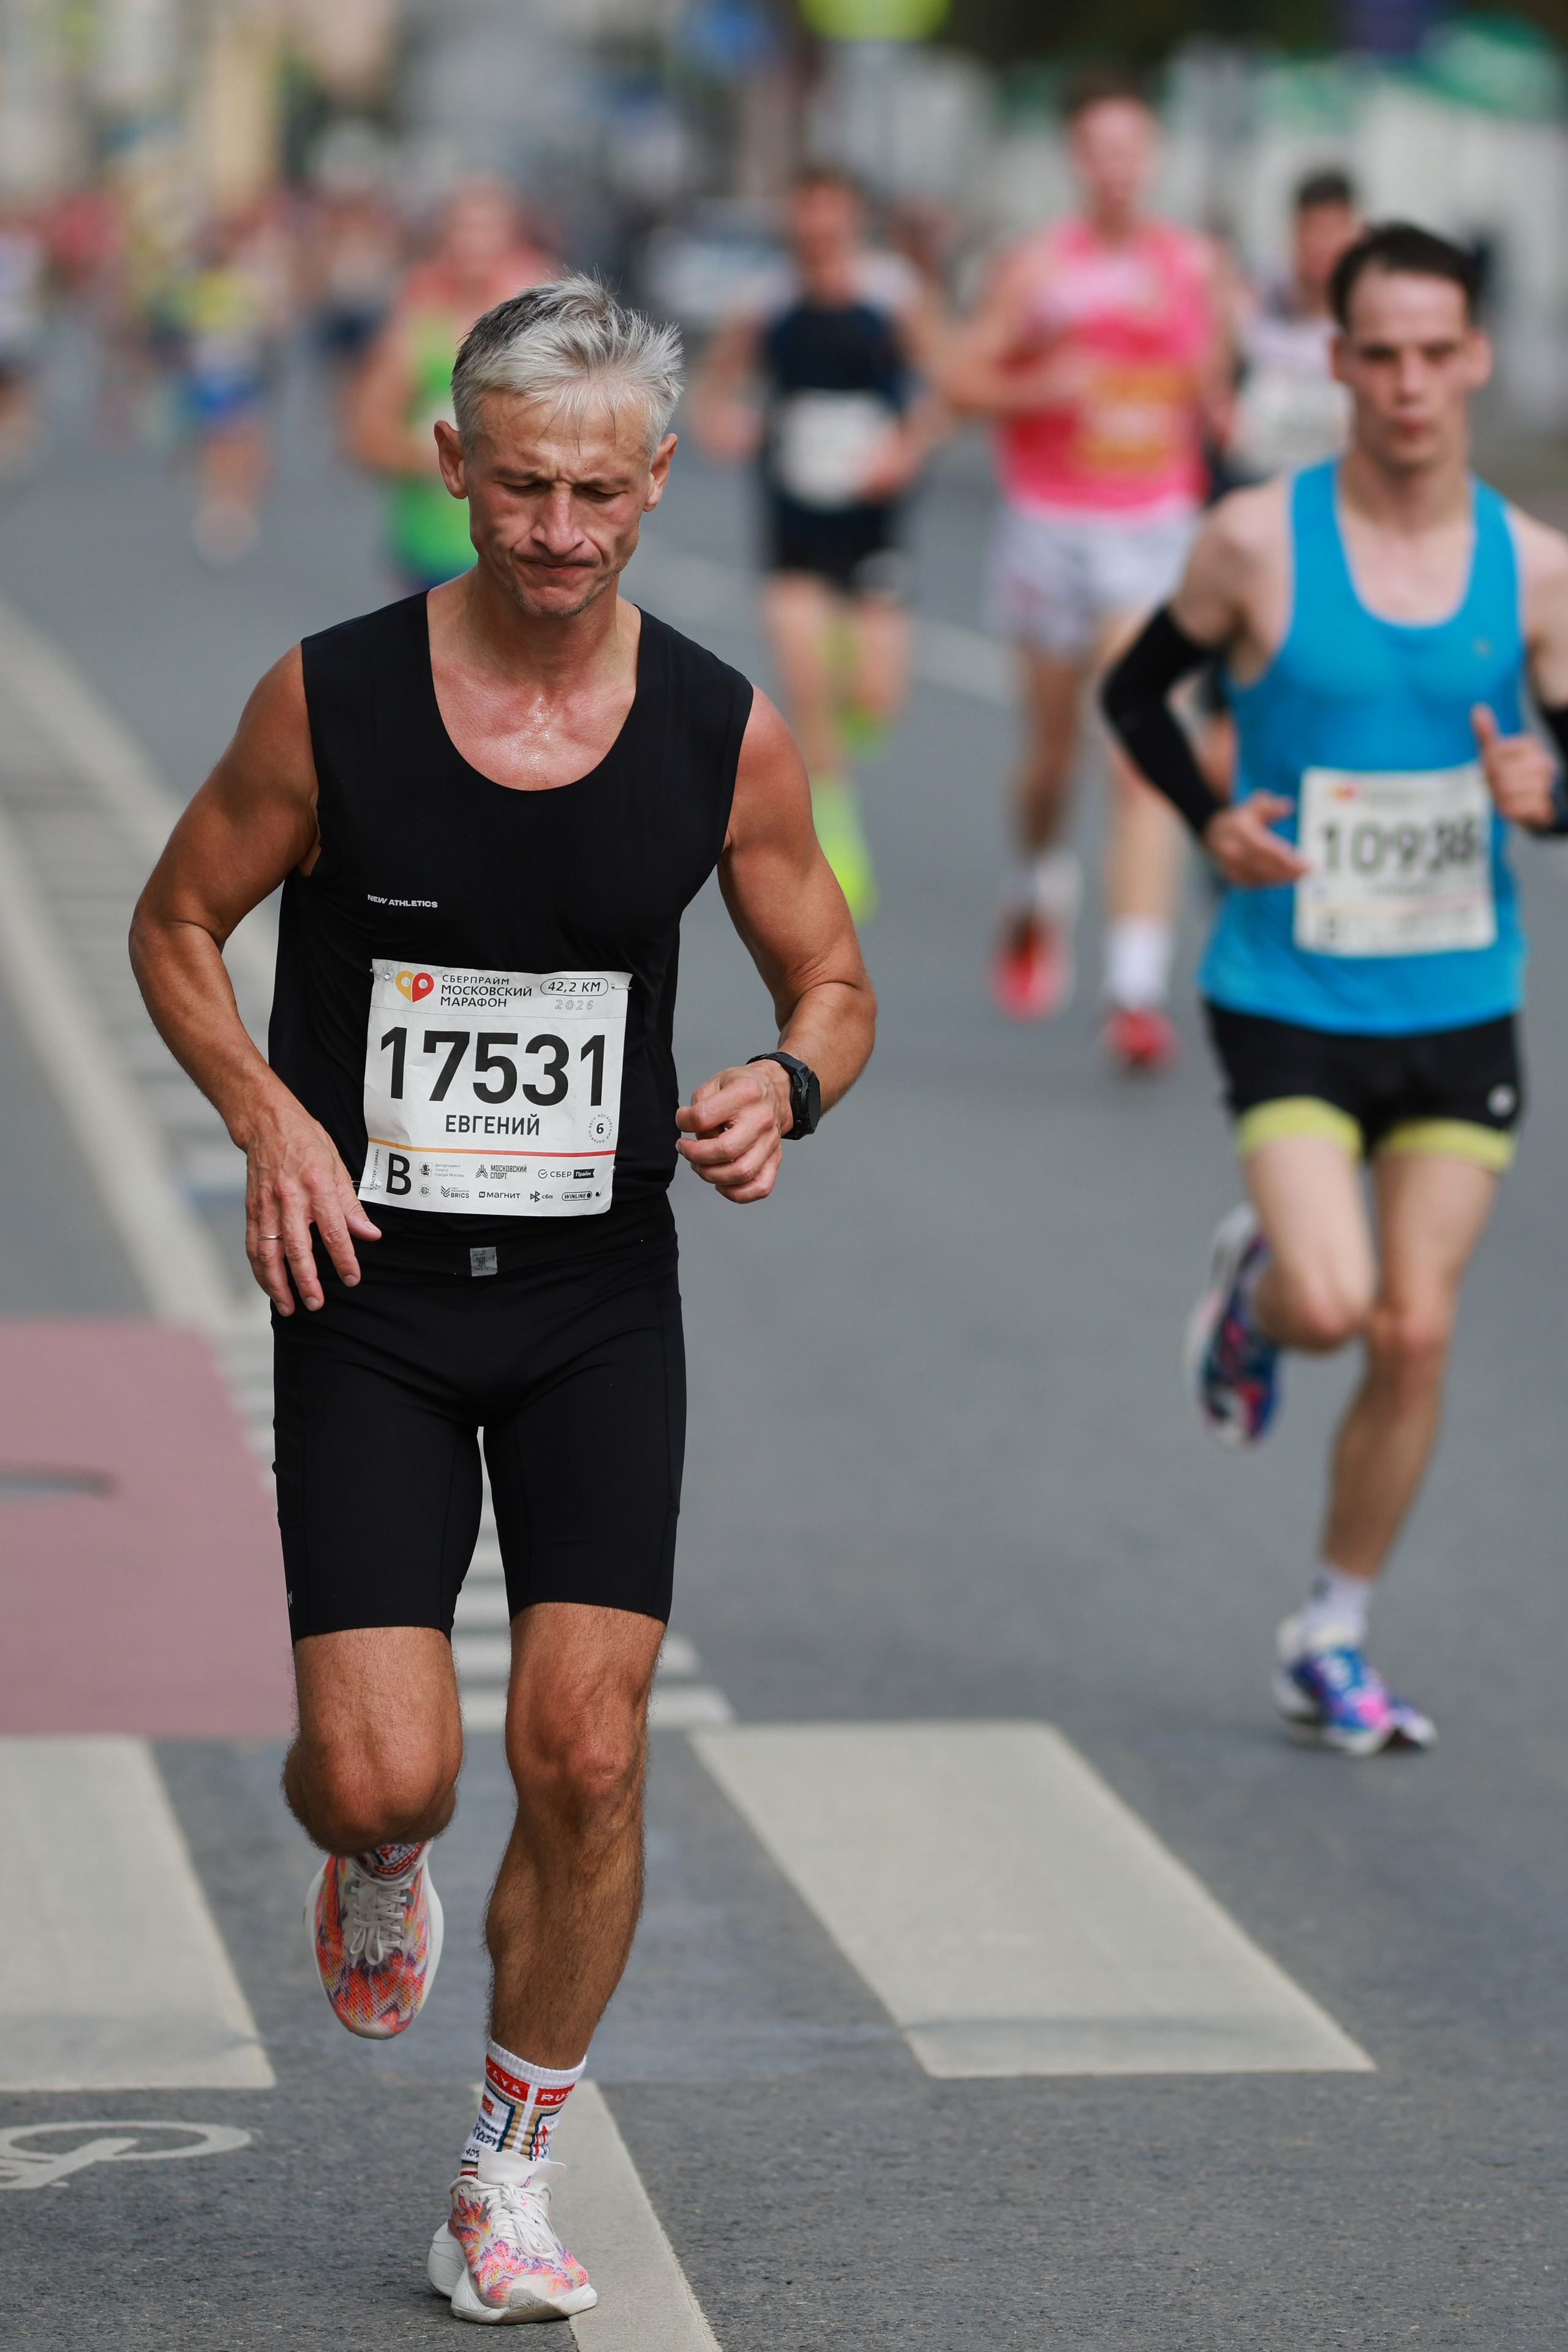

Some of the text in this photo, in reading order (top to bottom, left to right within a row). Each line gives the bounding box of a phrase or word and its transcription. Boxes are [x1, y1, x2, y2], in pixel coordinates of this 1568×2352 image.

[368, 894, 438, 908] NEW ATHLETICS
[442, 974, 510, 985] СБЕРПРАЙМ
[441, 984, 532, 997] МОСКОВСКИЙ
[548, 981, 577, 993] 42,2
[440, 997, 507, 1008] МАРАФОН
[554, 999, 594, 1010] 2026
[381, 1027, 605, 1106] 17531
[445, 1114, 540, 1136] ЕВГЕНИЙ
[597, 1123, 604, 1134] 6
[491, 1164, 527, 1173] МОСКОВСКИЙ
